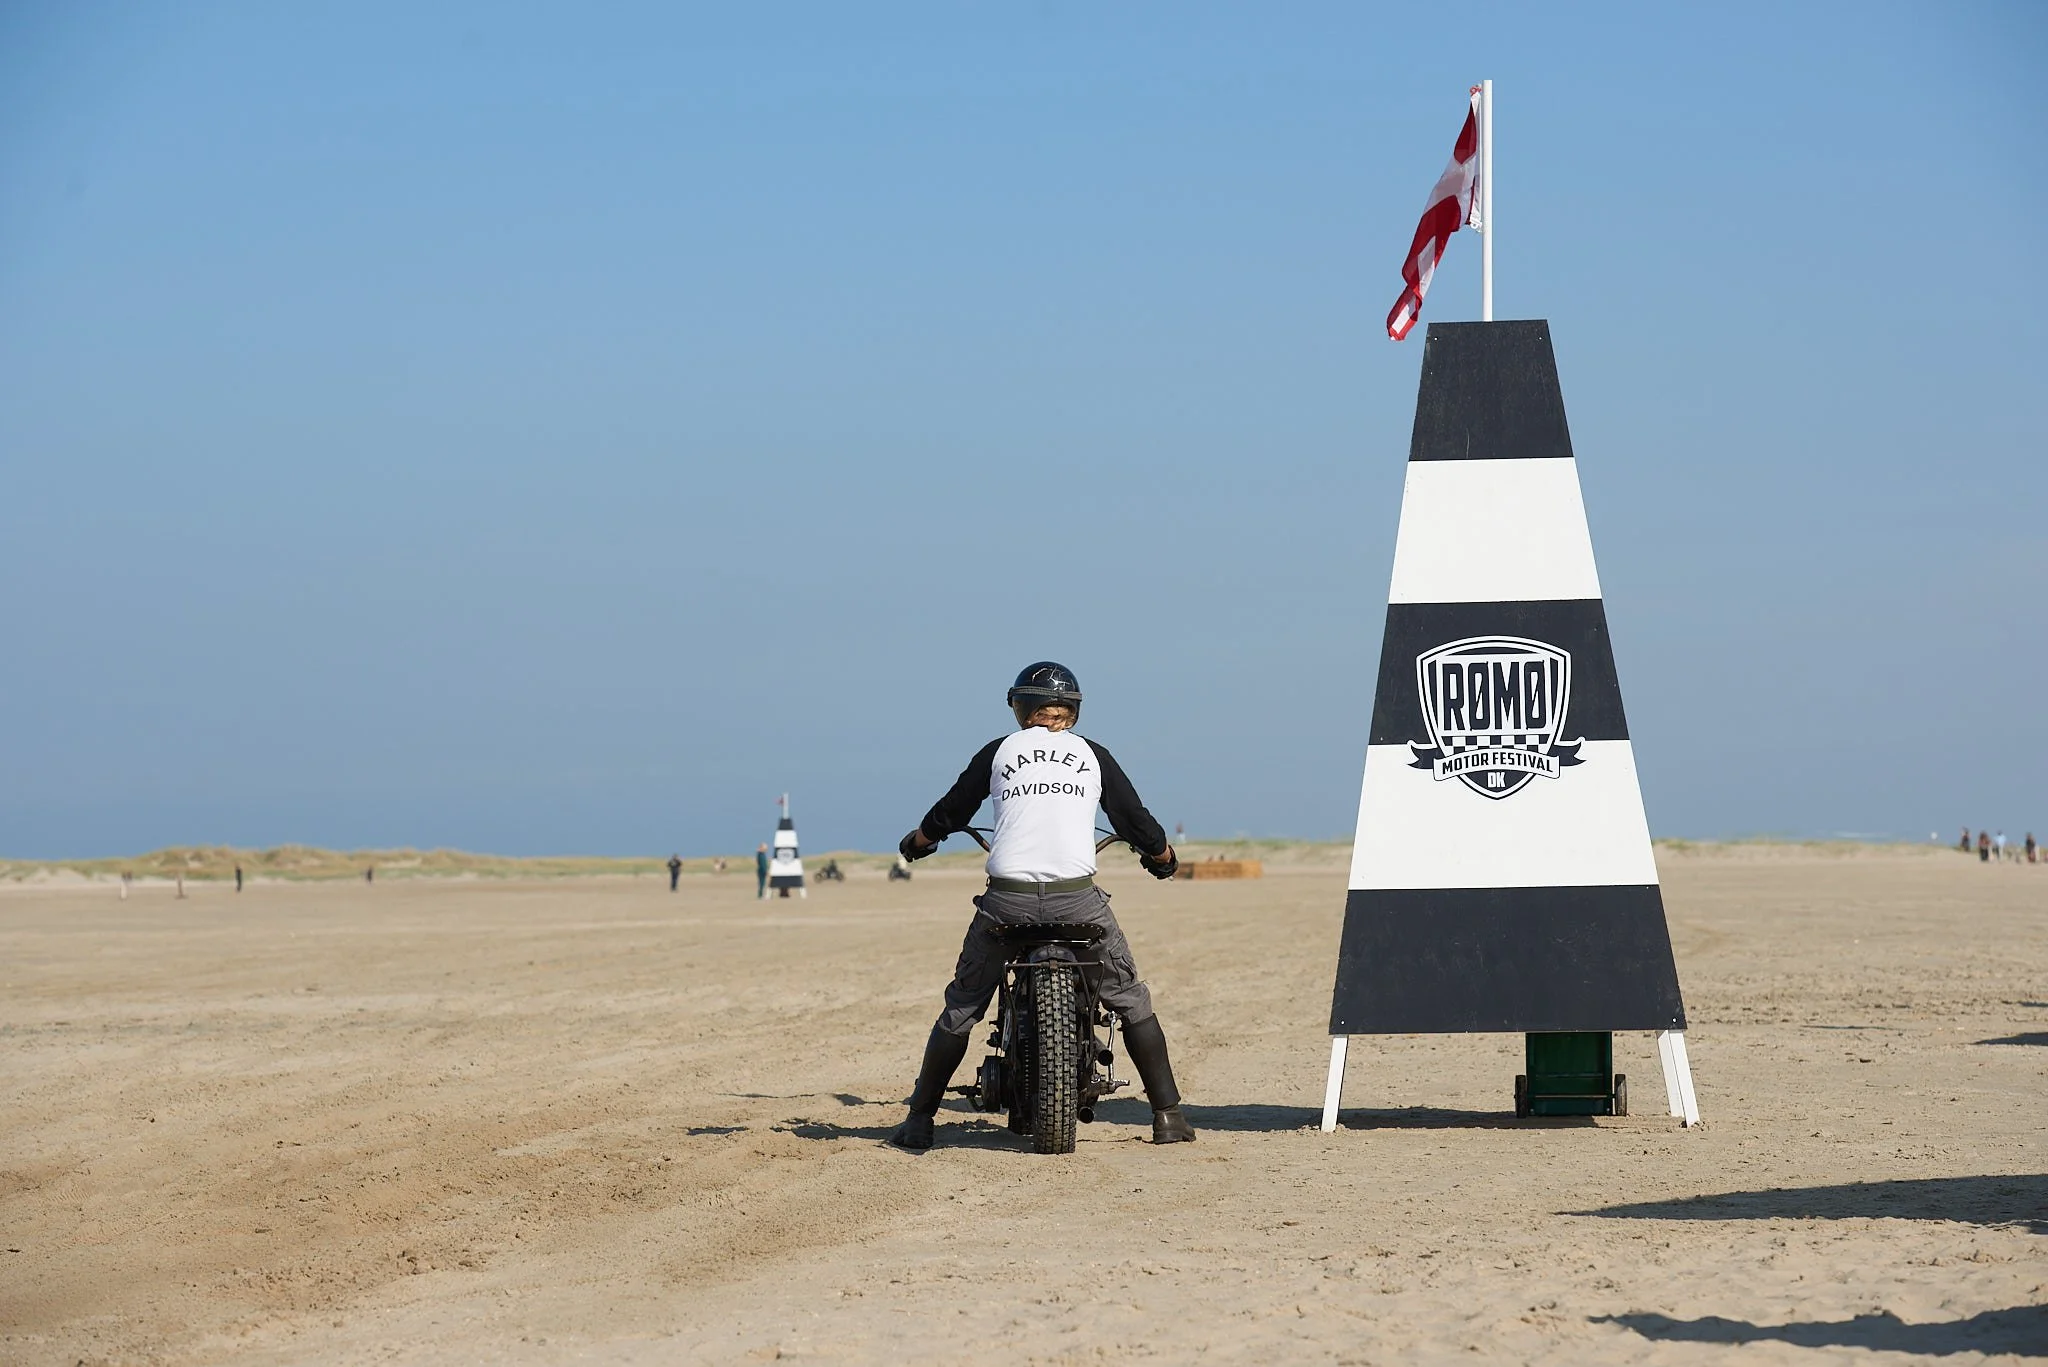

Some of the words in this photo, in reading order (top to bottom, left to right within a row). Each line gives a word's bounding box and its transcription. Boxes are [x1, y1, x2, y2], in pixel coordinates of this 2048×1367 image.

[1442, 660, 1547, 731] RØMØ
[1001, 749, 1090, 782] HARLEY
[1442, 752, 1489, 775] MOTOR
[1492, 751, 1553, 773] FESTIVAL
[1001, 782, 1085, 802] DAVIDSON
[1487, 772, 1506, 788] DK
